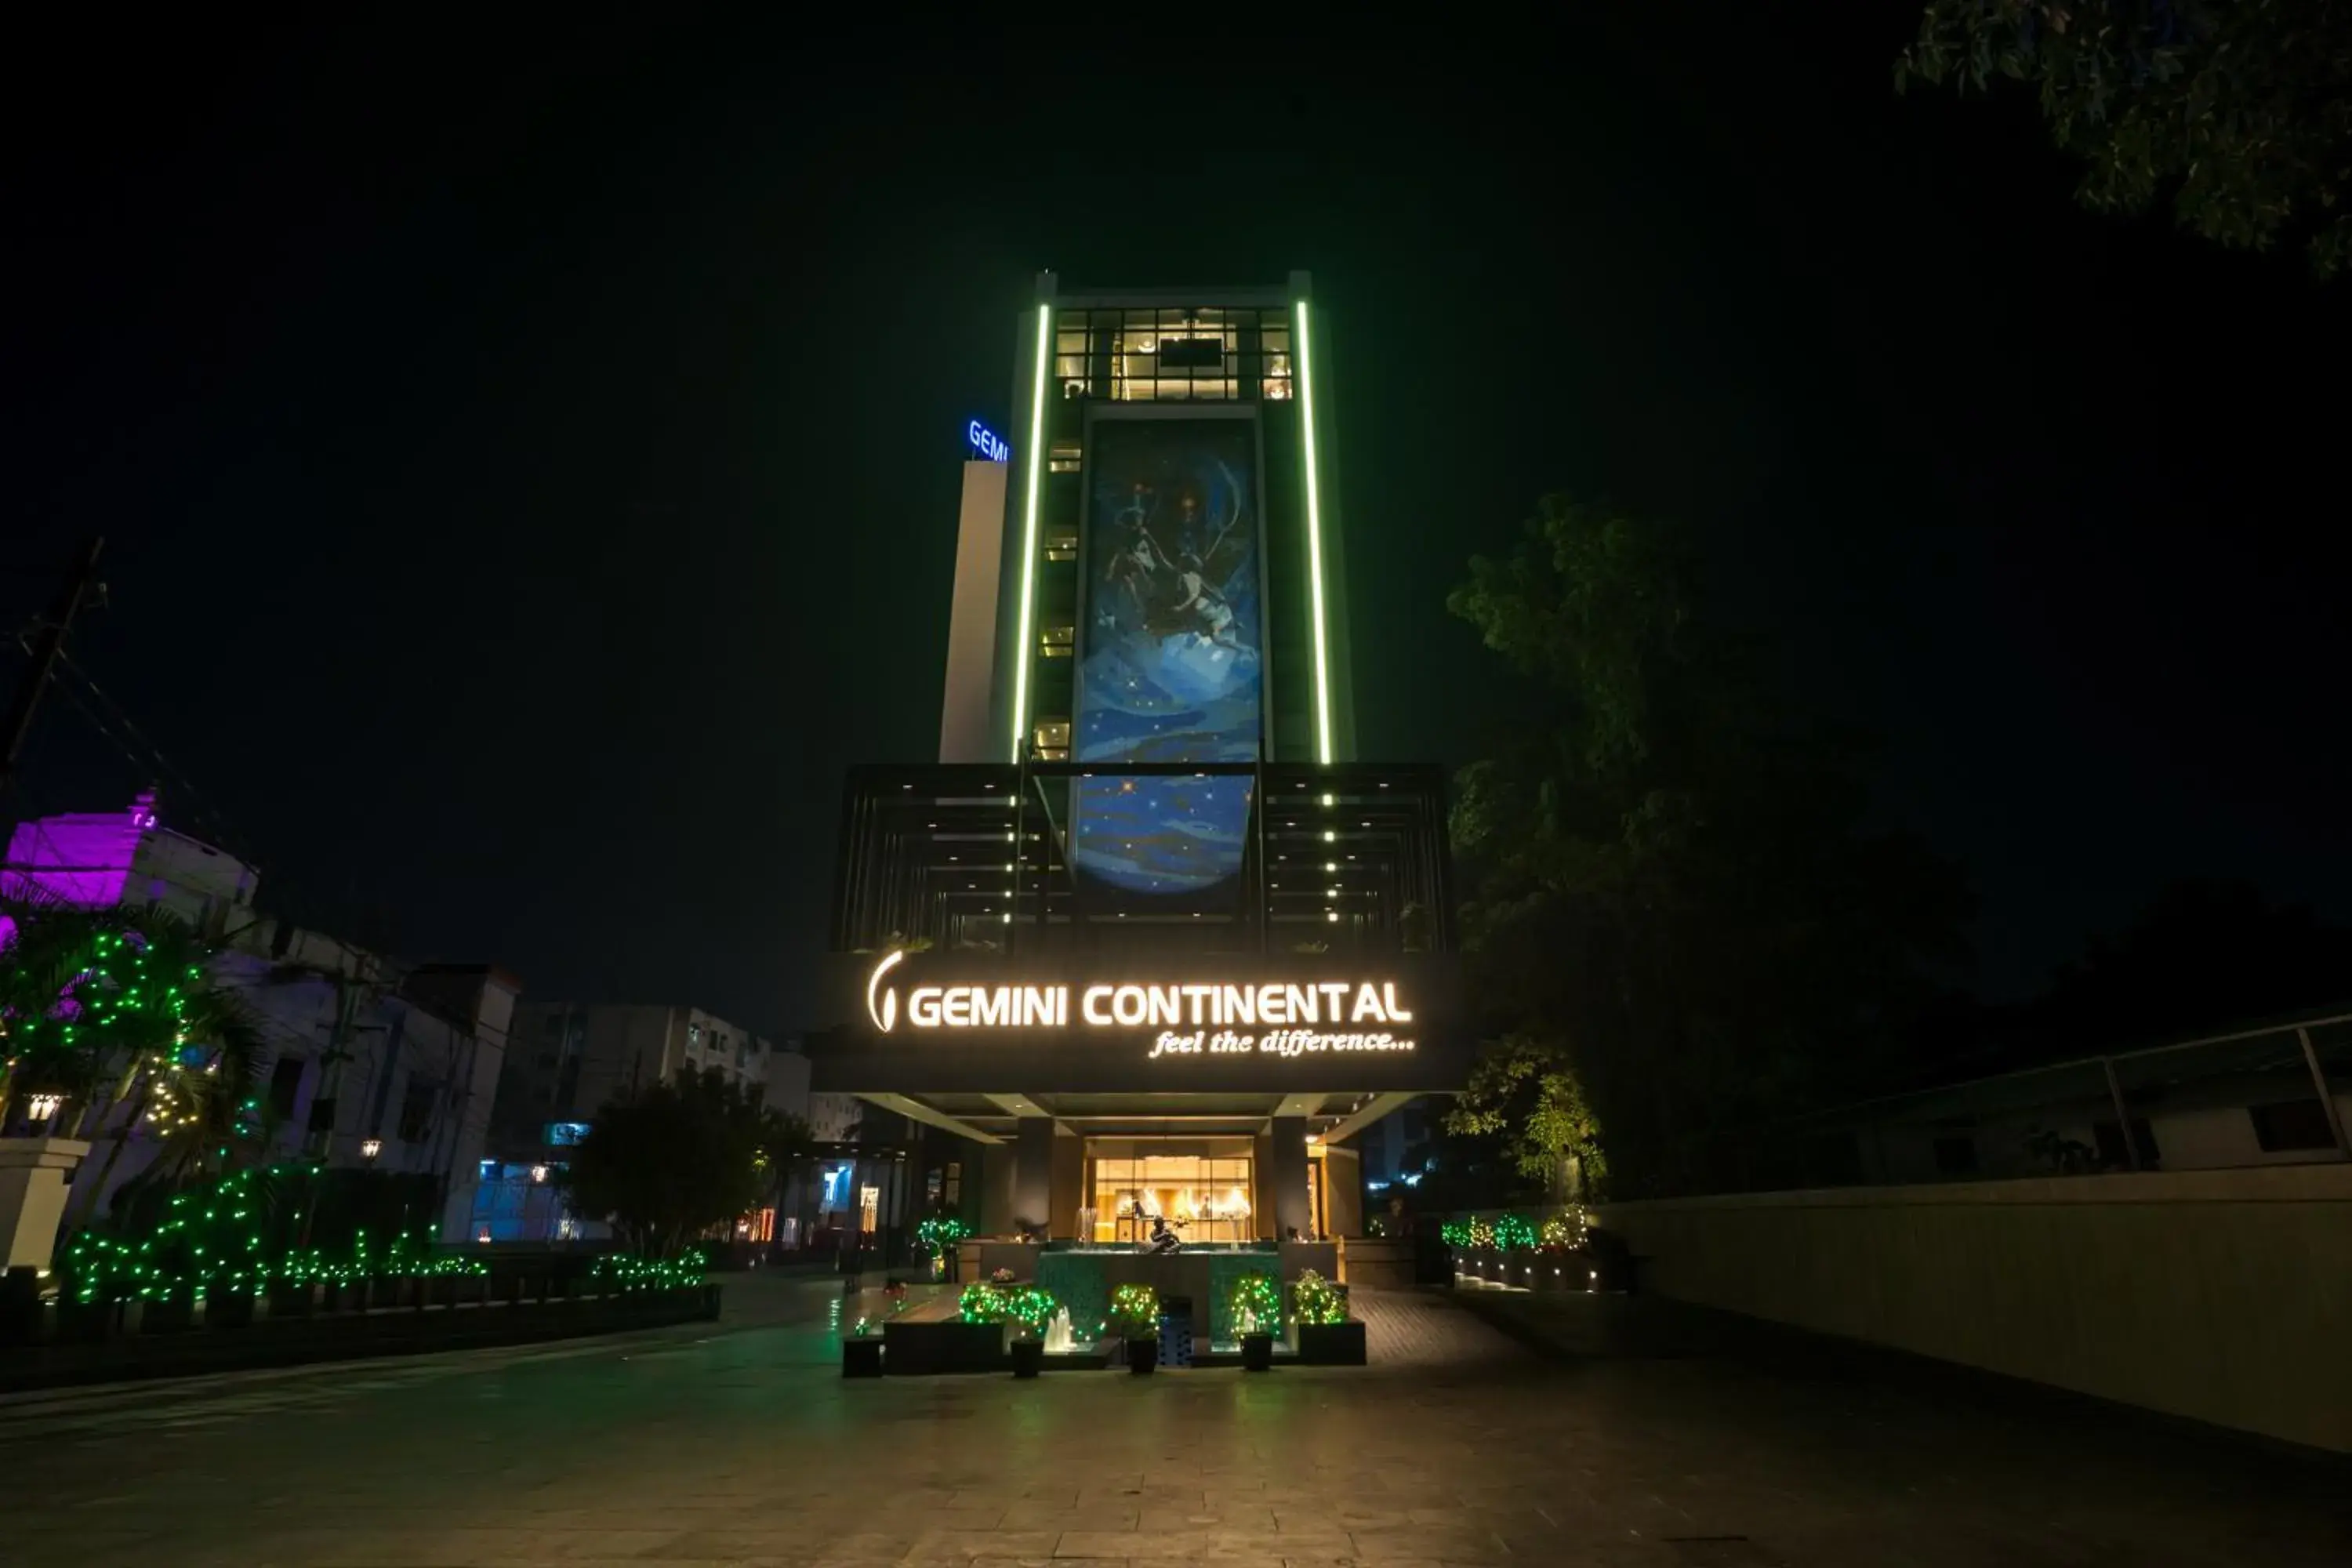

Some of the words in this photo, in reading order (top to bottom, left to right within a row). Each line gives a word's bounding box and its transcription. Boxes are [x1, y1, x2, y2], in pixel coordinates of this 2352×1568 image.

[908, 986, 1067, 1026] GEMINI
[1082, 982, 1412, 1026] CONTINENTAL
[1149, 1031, 1204, 1058] feel
[1210, 1030, 1254, 1054] the
